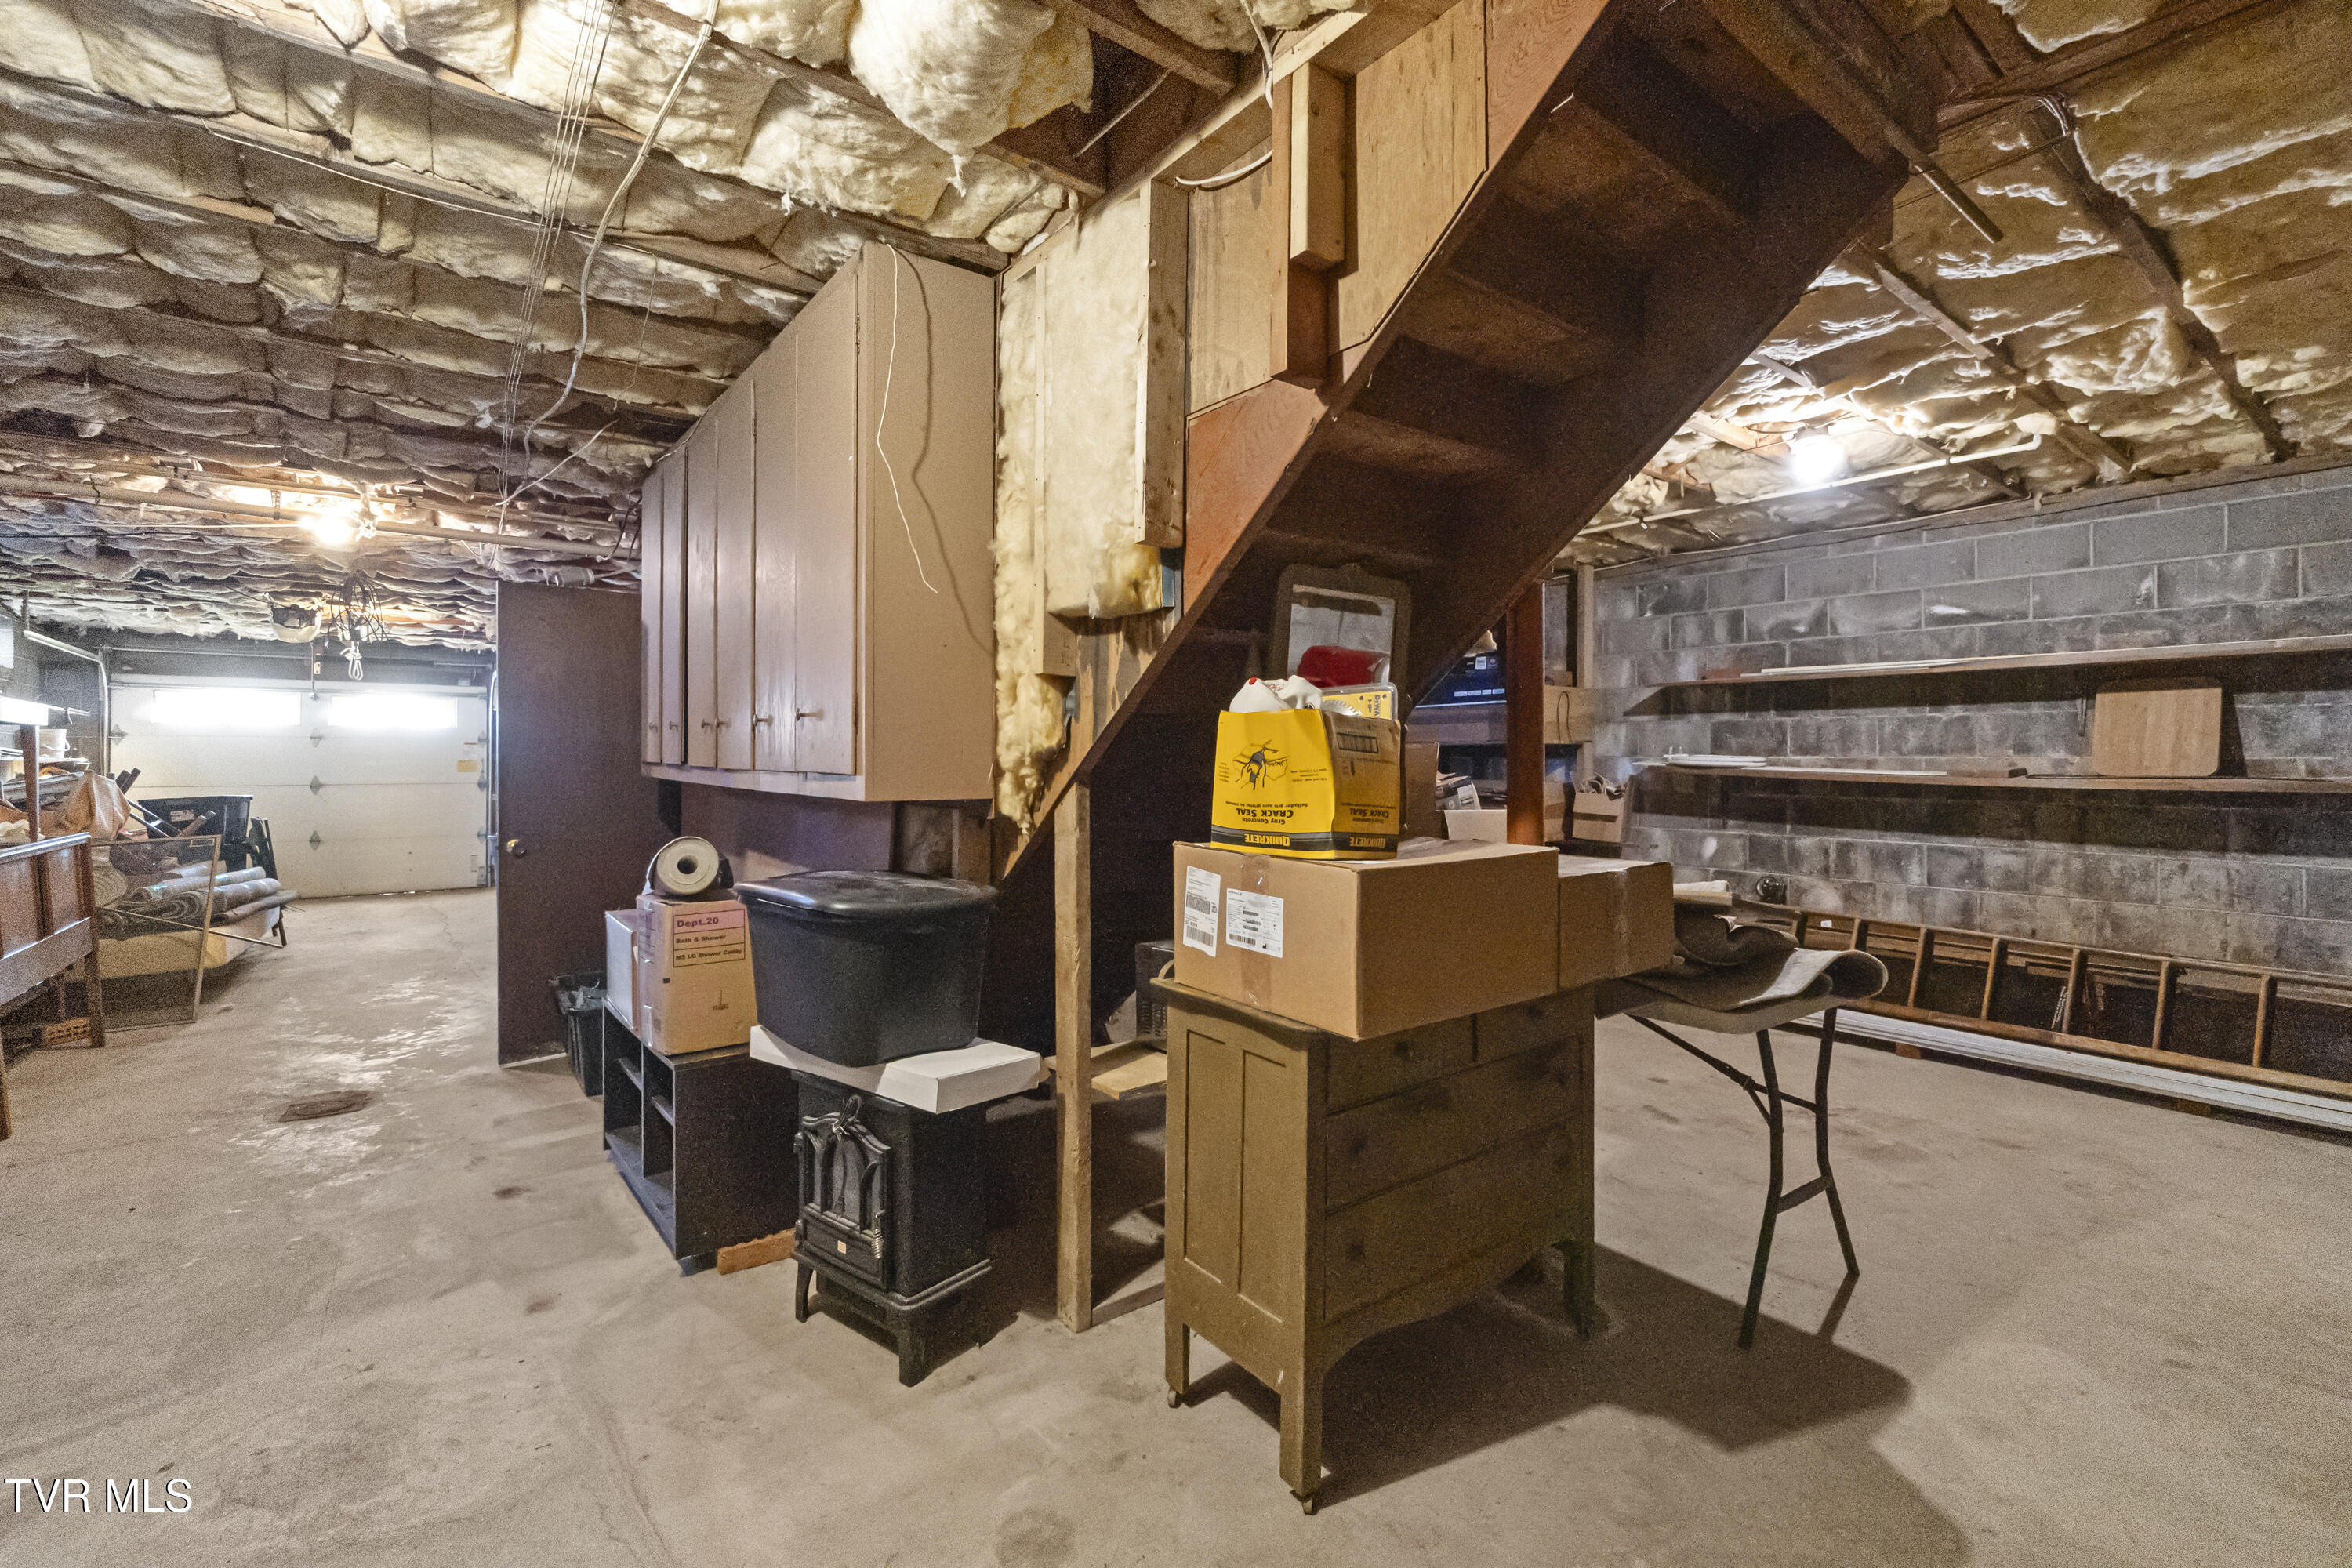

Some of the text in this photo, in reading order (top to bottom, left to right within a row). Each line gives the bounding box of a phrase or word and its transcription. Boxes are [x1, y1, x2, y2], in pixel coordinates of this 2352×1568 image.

[1236, 808, 1294, 818] CRACK SEAL
[1349, 808, 1389, 818] CRACK SEAL
[1244, 833, 1290, 847] QUIKRETE
[677, 917, 719, 928] Dept.20
